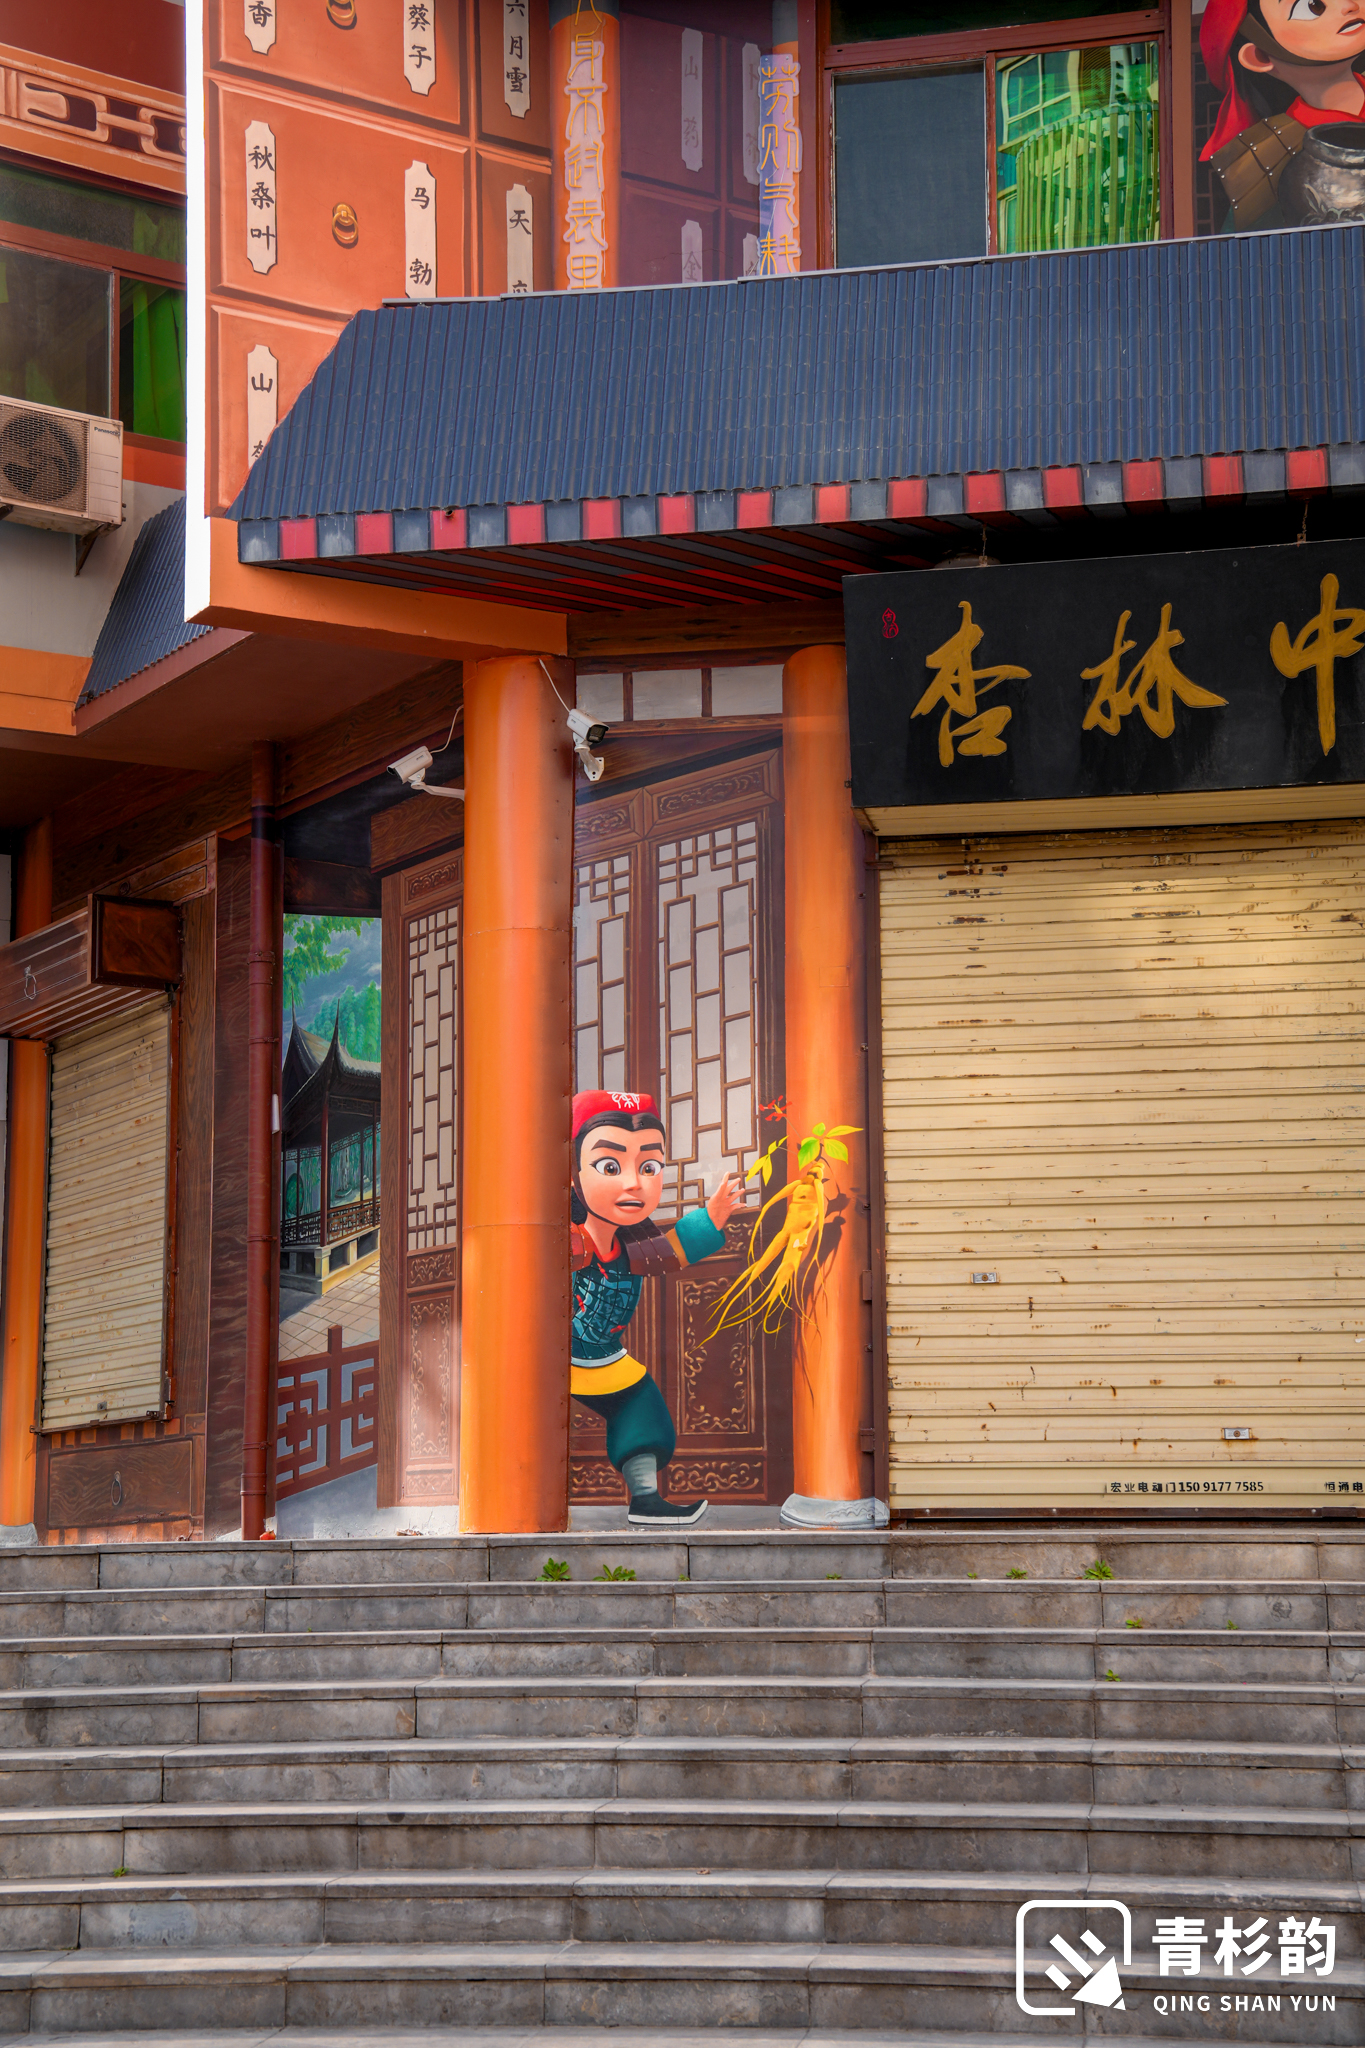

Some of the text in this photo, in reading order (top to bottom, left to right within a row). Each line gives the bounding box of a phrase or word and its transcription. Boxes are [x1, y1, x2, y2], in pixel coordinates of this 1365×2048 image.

[248, 0, 273, 28] 香
[408, 3, 432, 69] 葵子
[506, 0, 528, 94] 六月雪
[684, 55, 699, 149] 山药
[247, 145, 276, 251] 秋桑叶
[409, 186, 433, 286] 马勃
[909, 572, 1365, 768] 杏林中
[1110, 1481, 1176, 1493] 宏业电动门
